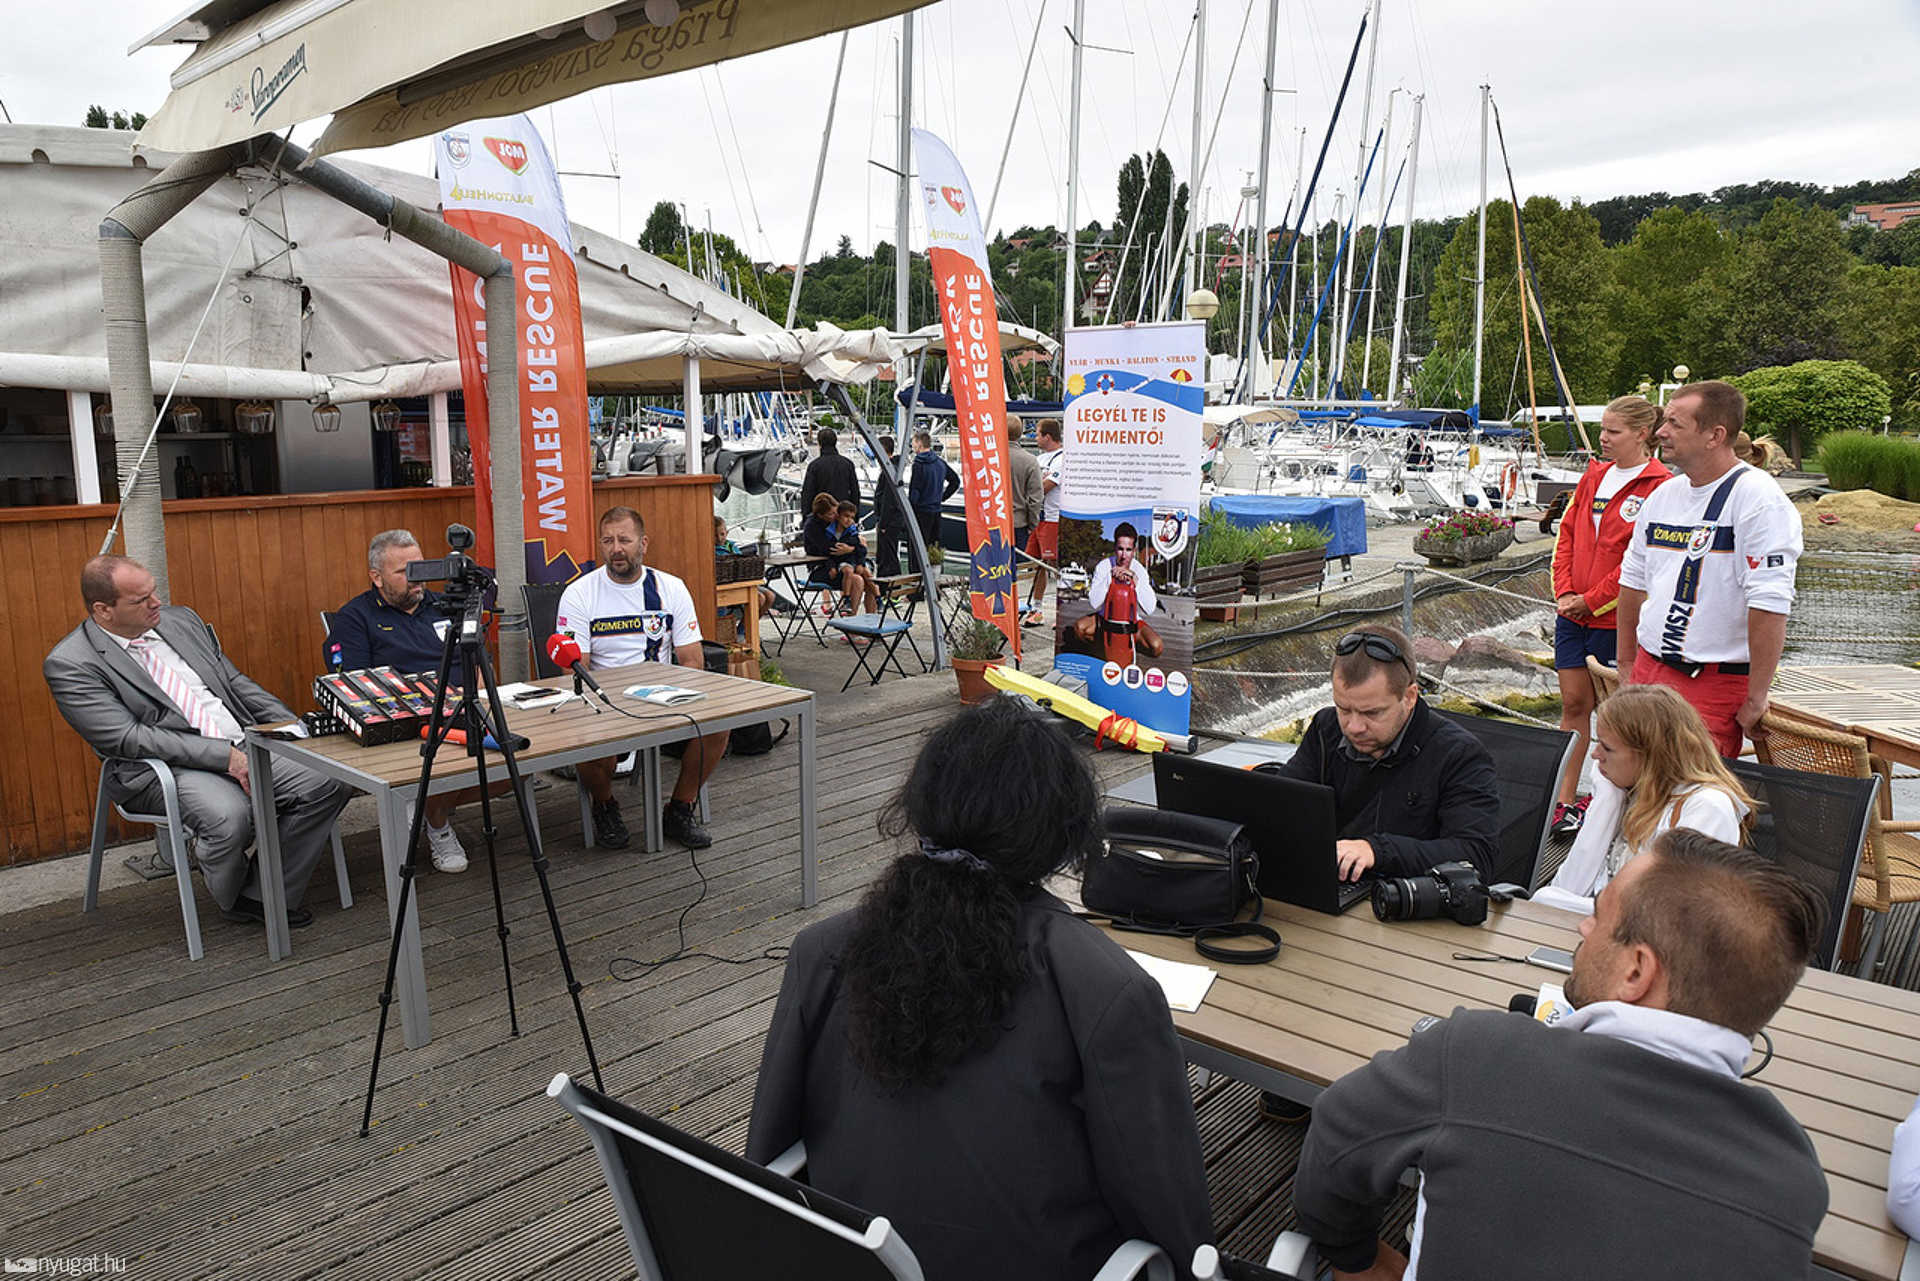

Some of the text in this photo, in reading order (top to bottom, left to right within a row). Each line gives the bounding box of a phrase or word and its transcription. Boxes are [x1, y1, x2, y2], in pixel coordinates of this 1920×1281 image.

[1077, 404, 1166, 423] LEGYÉL TE IS
[1076, 426, 1163, 445] VÍZIMENTŐ!
